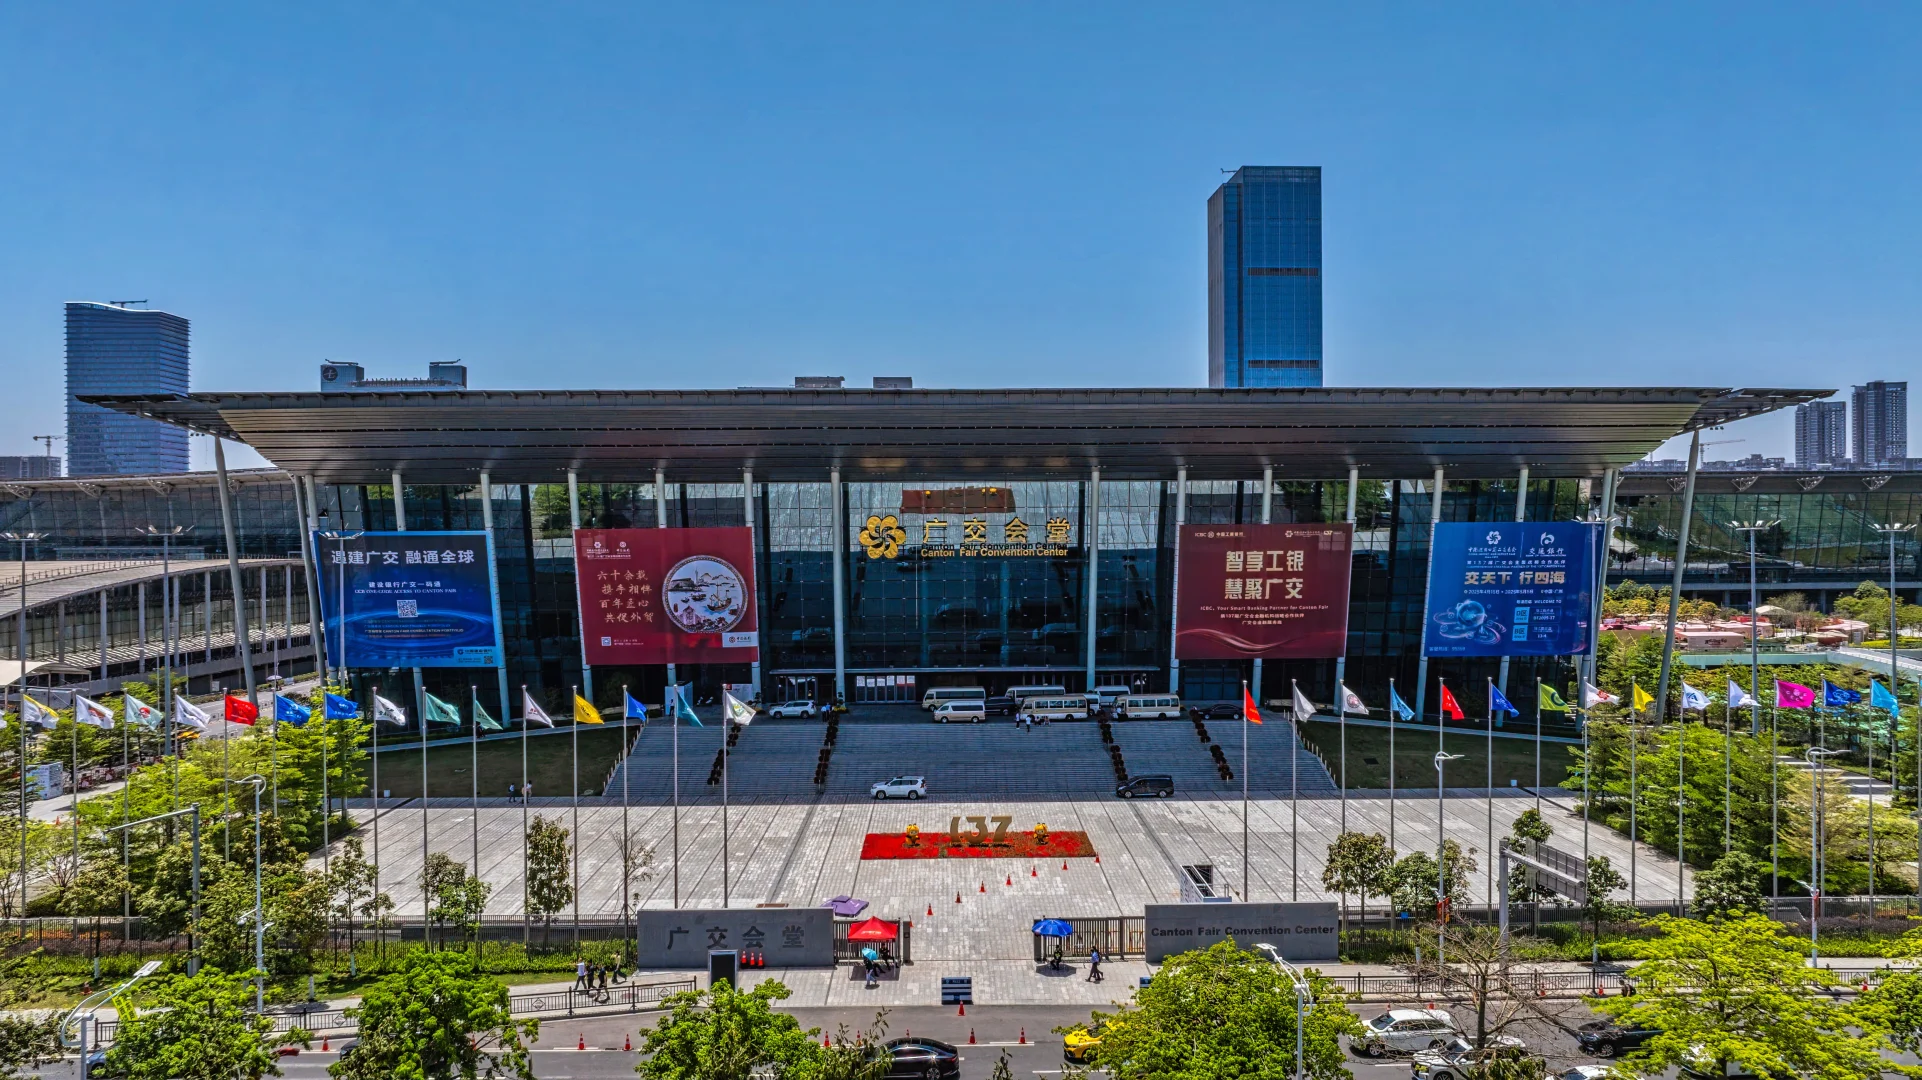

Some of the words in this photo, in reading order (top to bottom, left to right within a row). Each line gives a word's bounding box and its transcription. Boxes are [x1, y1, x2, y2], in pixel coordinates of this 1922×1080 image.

[922, 517, 1071, 543] 广交会堂
[331, 551, 399, 564] 遇建广交
[405, 549, 475, 564] 融通全球
[921, 548, 955, 557] Canton
[959, 548, 978, 557] Fair
[980, 548, 1035, 557] Convention
[1037, 547, 1069, 556] Center
[1529, 547, 1564, 555] 交通银行
[1225, 550, 1304, 572] 智享工银
[597, 569, 648, 581] 六十余载
[1464, 571, 1513, 585] 交天下
[1519, 571, 1566, 585] 行四海
[602, 583, 653, 596] 携手相伴
[1224, 577, 1304, 600] 慧聚广交
[599, 598, 649, 609] 百年匠心
[604, 612, 654, 624] 共促外贸
[950, 816, 1012, 843] 137
[667, 925, 805, 949] 广交会堂
[1151, 927, 1193, 937] Canton
[1197, 927, 1221, 936] Fair
[1224, 926, 1291, 936] Convention
[1295, 925, 1335, 935] Center
